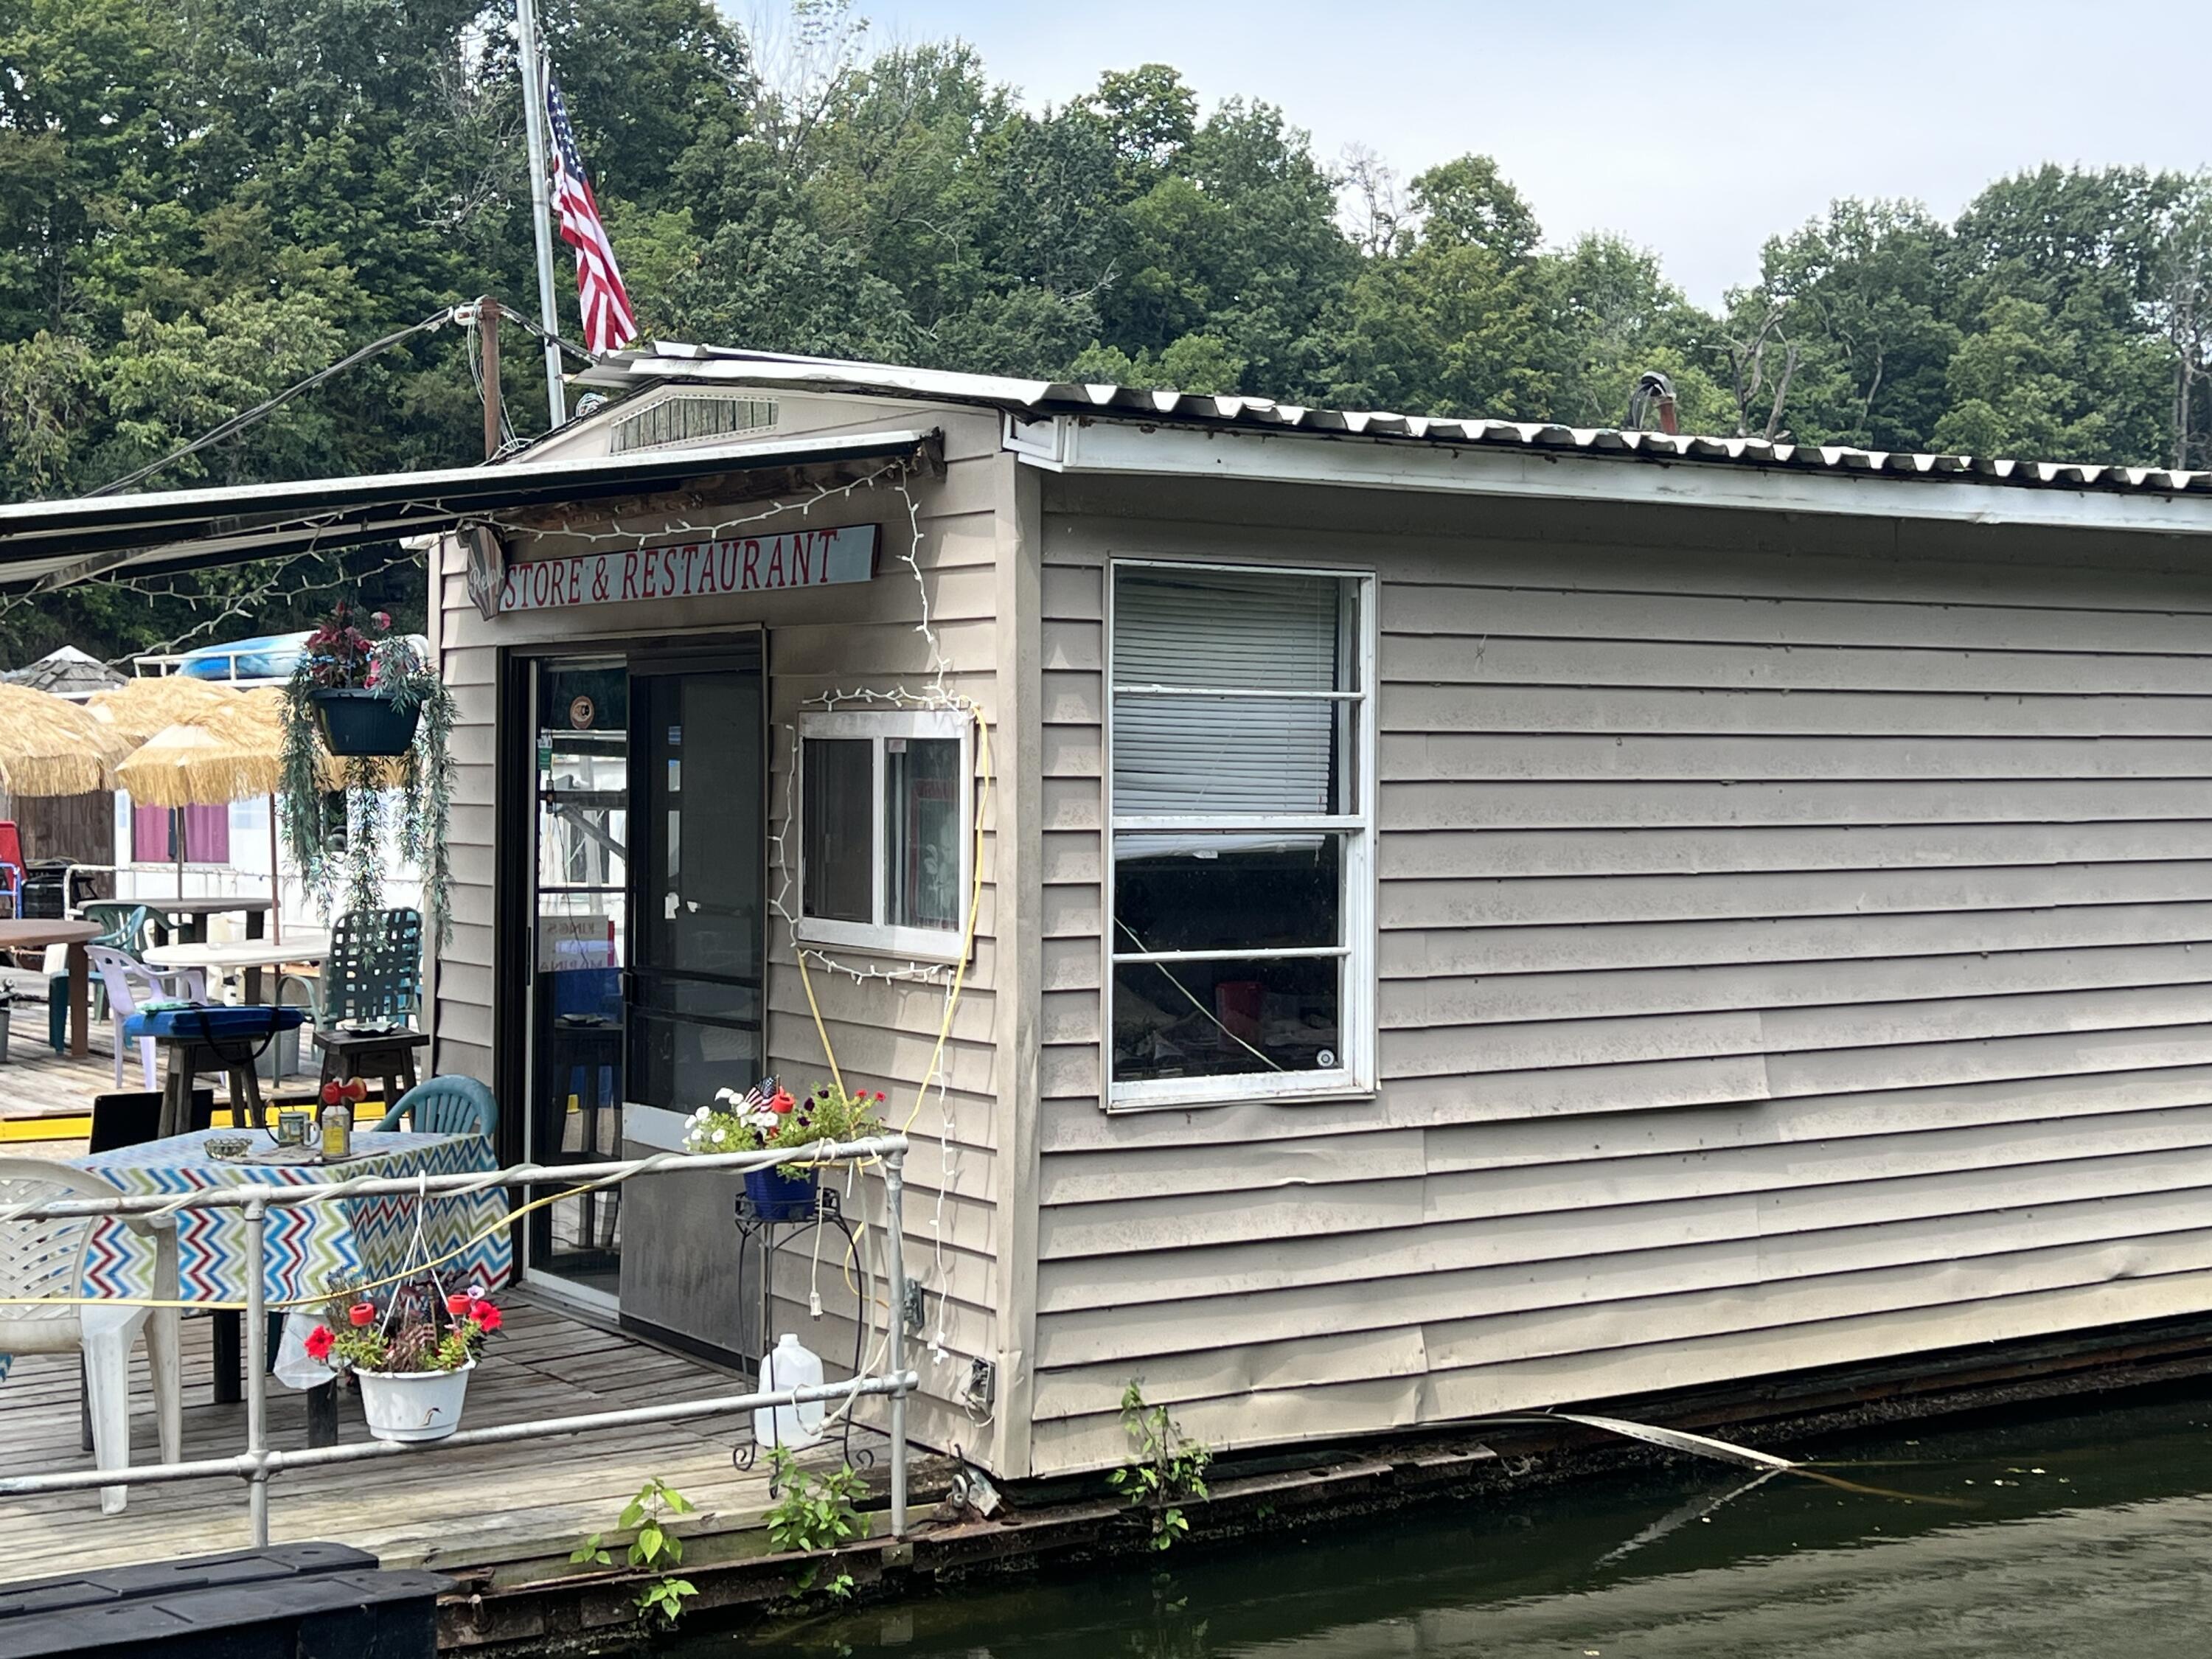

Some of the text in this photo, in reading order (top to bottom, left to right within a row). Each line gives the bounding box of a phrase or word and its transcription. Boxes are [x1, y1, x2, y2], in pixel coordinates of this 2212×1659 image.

[505, 530, 838, 608] STORE & RESTAURANT
